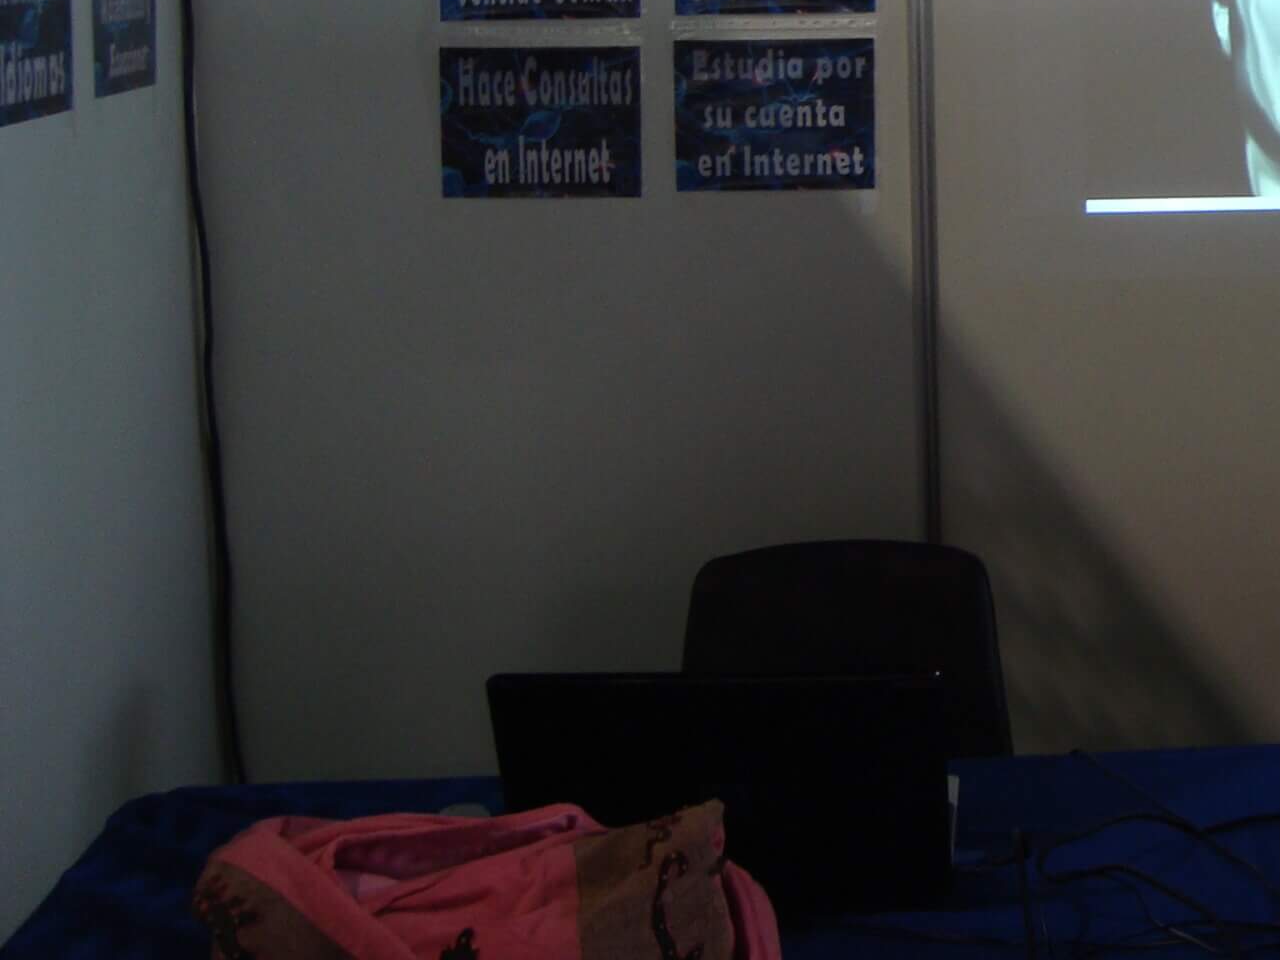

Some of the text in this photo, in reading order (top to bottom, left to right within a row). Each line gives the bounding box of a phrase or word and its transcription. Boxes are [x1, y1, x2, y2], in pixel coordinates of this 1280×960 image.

[458, 56, 634, 107] Hace Consultas
[692, 48, 867, 85] Estudia por
[703, 99, 846, 130] su cuenta
[484, 135, 614, 185] en Internet
[699, 144, 866, 177] en Internet
